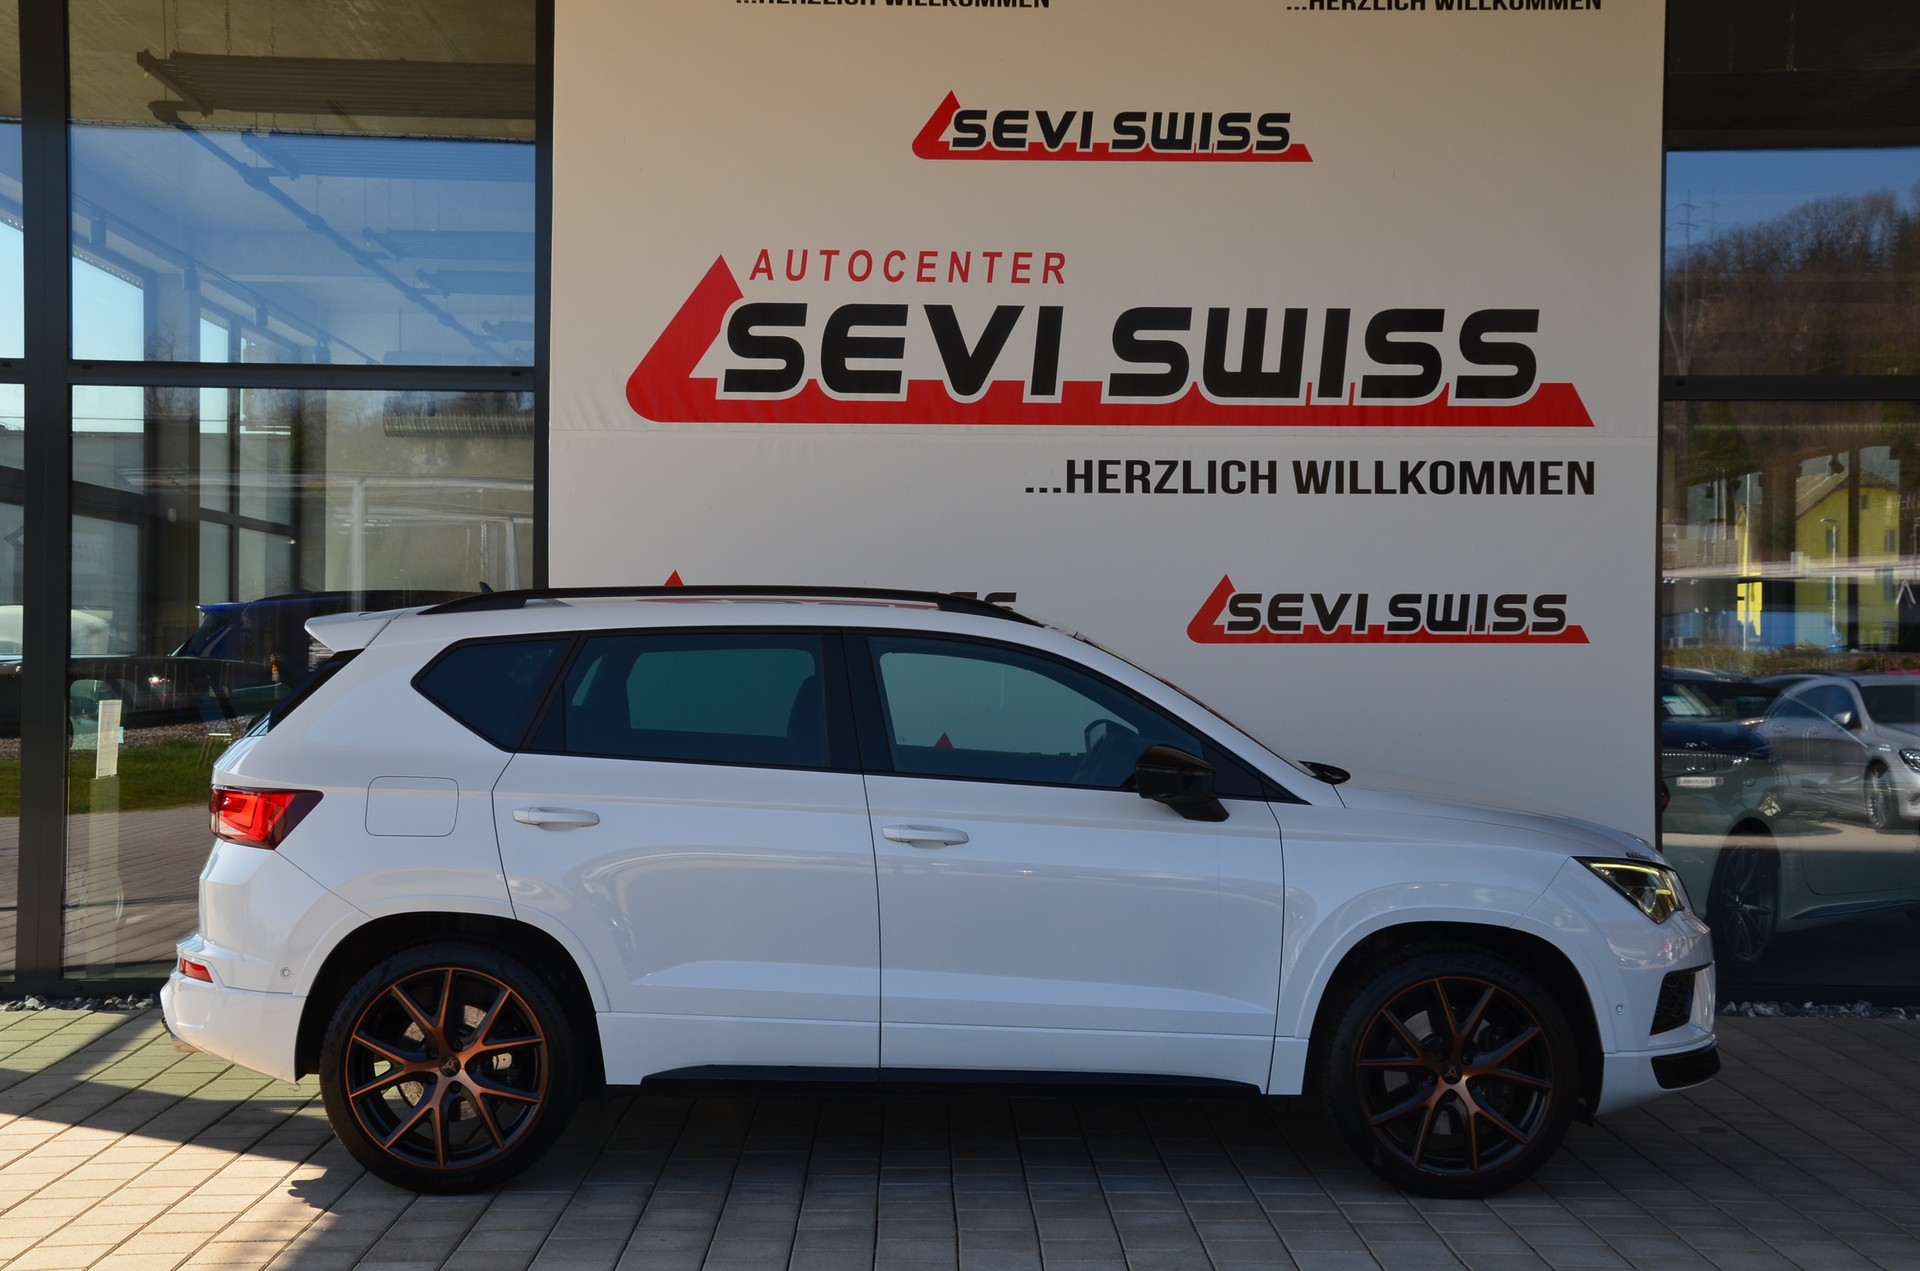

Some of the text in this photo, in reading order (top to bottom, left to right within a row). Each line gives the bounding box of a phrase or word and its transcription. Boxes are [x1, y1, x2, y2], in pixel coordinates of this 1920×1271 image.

[951, 110, 1293, 153] SEVI SWISS
[748, 248, 1067, 285] AUTOCENTER
[722, 302, 1541, 400] SEVI SWISS
[1025, 459, 1595, 495] ...HERZLICH WILLKOMMEN
[1226, 592, 1568, 634] SEVI SWISS
